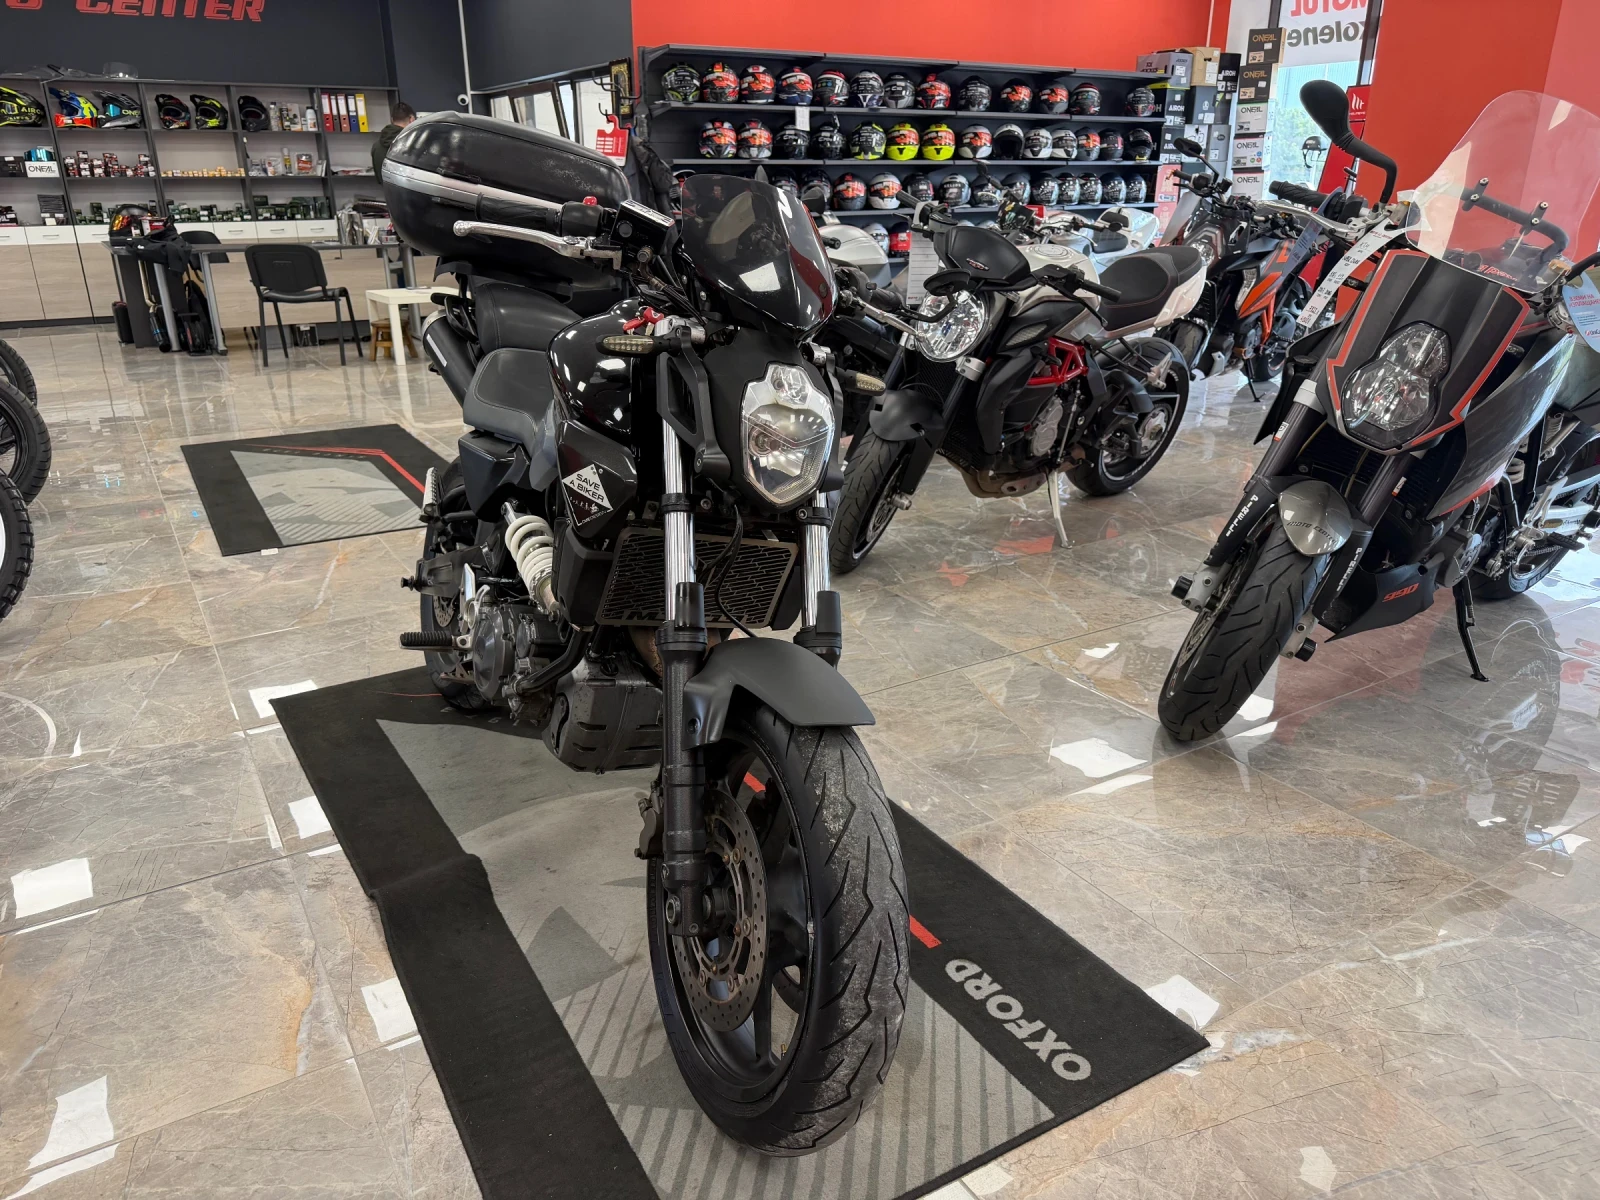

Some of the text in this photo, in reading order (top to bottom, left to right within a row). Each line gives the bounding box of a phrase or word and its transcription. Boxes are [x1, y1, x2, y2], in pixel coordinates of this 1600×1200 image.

[576, 473, 600, 491] SAVE
[577, 484, 604, 502] BIKER
[1225, 494, 1259, 537] PIRELLI
[1336, 547, 1363, 592] PIRELLI
[1382, 583, 1420, 602] 990
[944, 958, 1092, 1081] OXFORD
